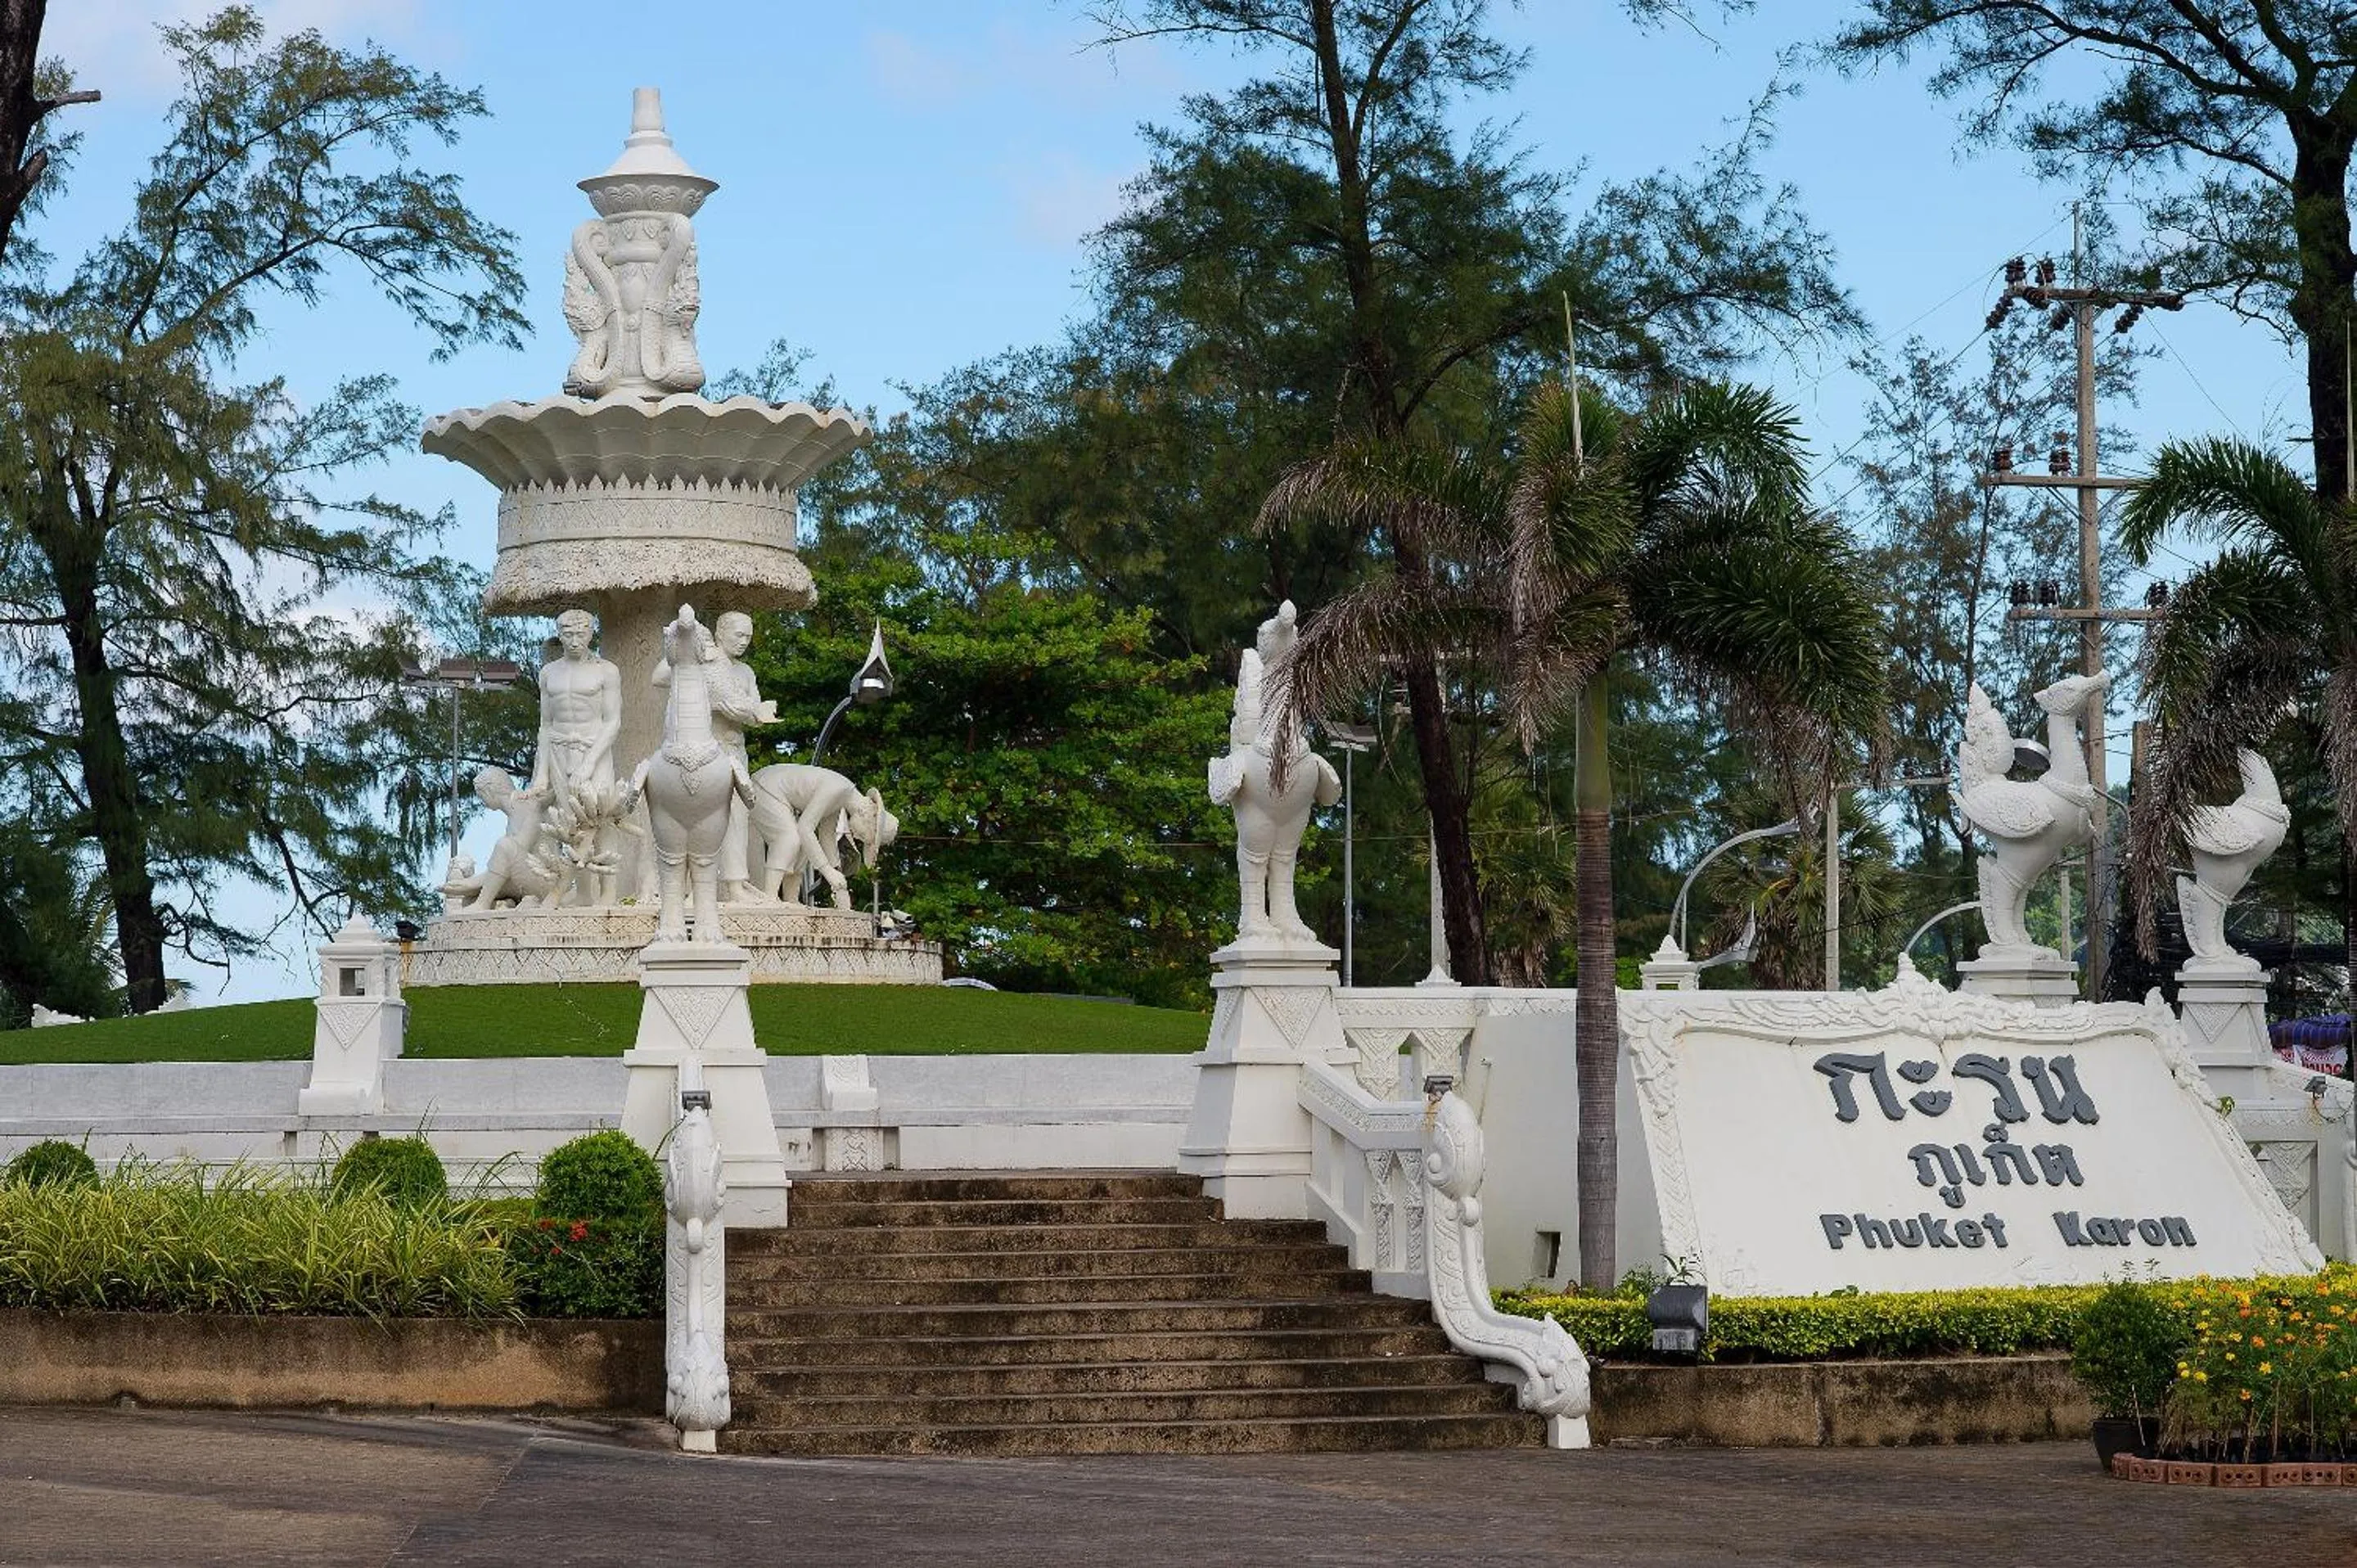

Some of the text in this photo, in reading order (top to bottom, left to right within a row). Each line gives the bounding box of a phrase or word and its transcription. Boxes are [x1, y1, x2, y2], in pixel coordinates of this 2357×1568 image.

[1813, 1052, 2099, 1124] กะรน
[1908, 1124, 2084, 1209] ภูเก็ต
[1819, 1210, 2197, 1249] Phuket Karon
